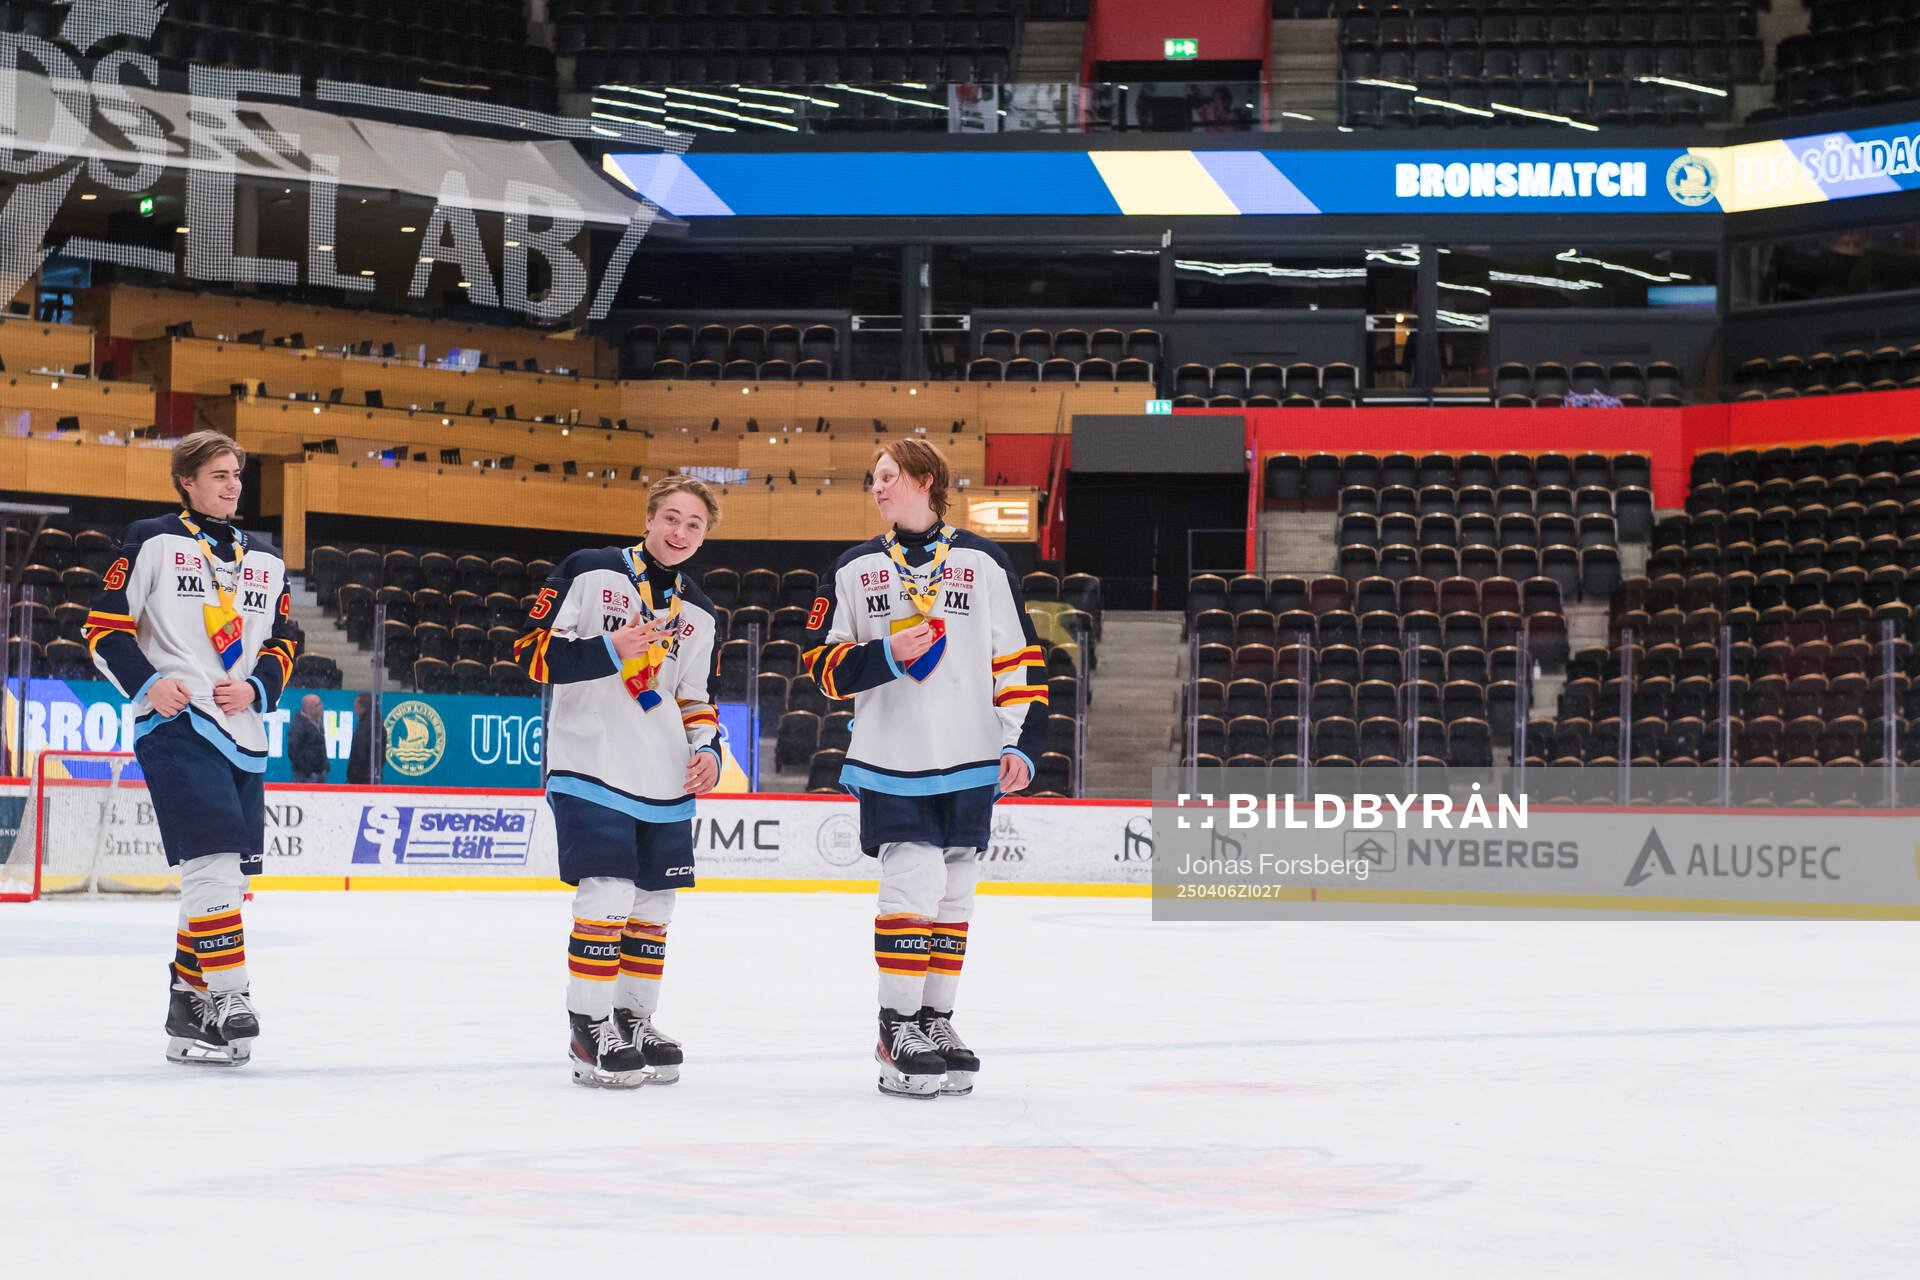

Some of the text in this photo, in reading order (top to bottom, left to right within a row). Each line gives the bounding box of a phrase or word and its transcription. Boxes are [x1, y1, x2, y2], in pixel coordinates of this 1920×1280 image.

[1395, 161, 1647, 198] BRONSMATCH
[406, 170, 588, 320] AB
[177, 575, 205, 592] XXL
[860, 569, 890, 587] B2B
[942, 567, 975, 583] B2B
[602, 589, 630, 609] B2B
[866, 594, 890, 613] XXL
[944, 590, 970, 610] XXL
[806, 597, 829, 630] 8
[419, 808, 526, 832] svenska
[267, 835, 302, 857] AB
[452, 837, 494, 860] tält
[1407, 839, 1579, 868] NYBERGS
[1687, 844, 1841, 880] ALUSPEC
[207, 904, 229, 912] CCM
[583, 943, 621, 958] nordic
